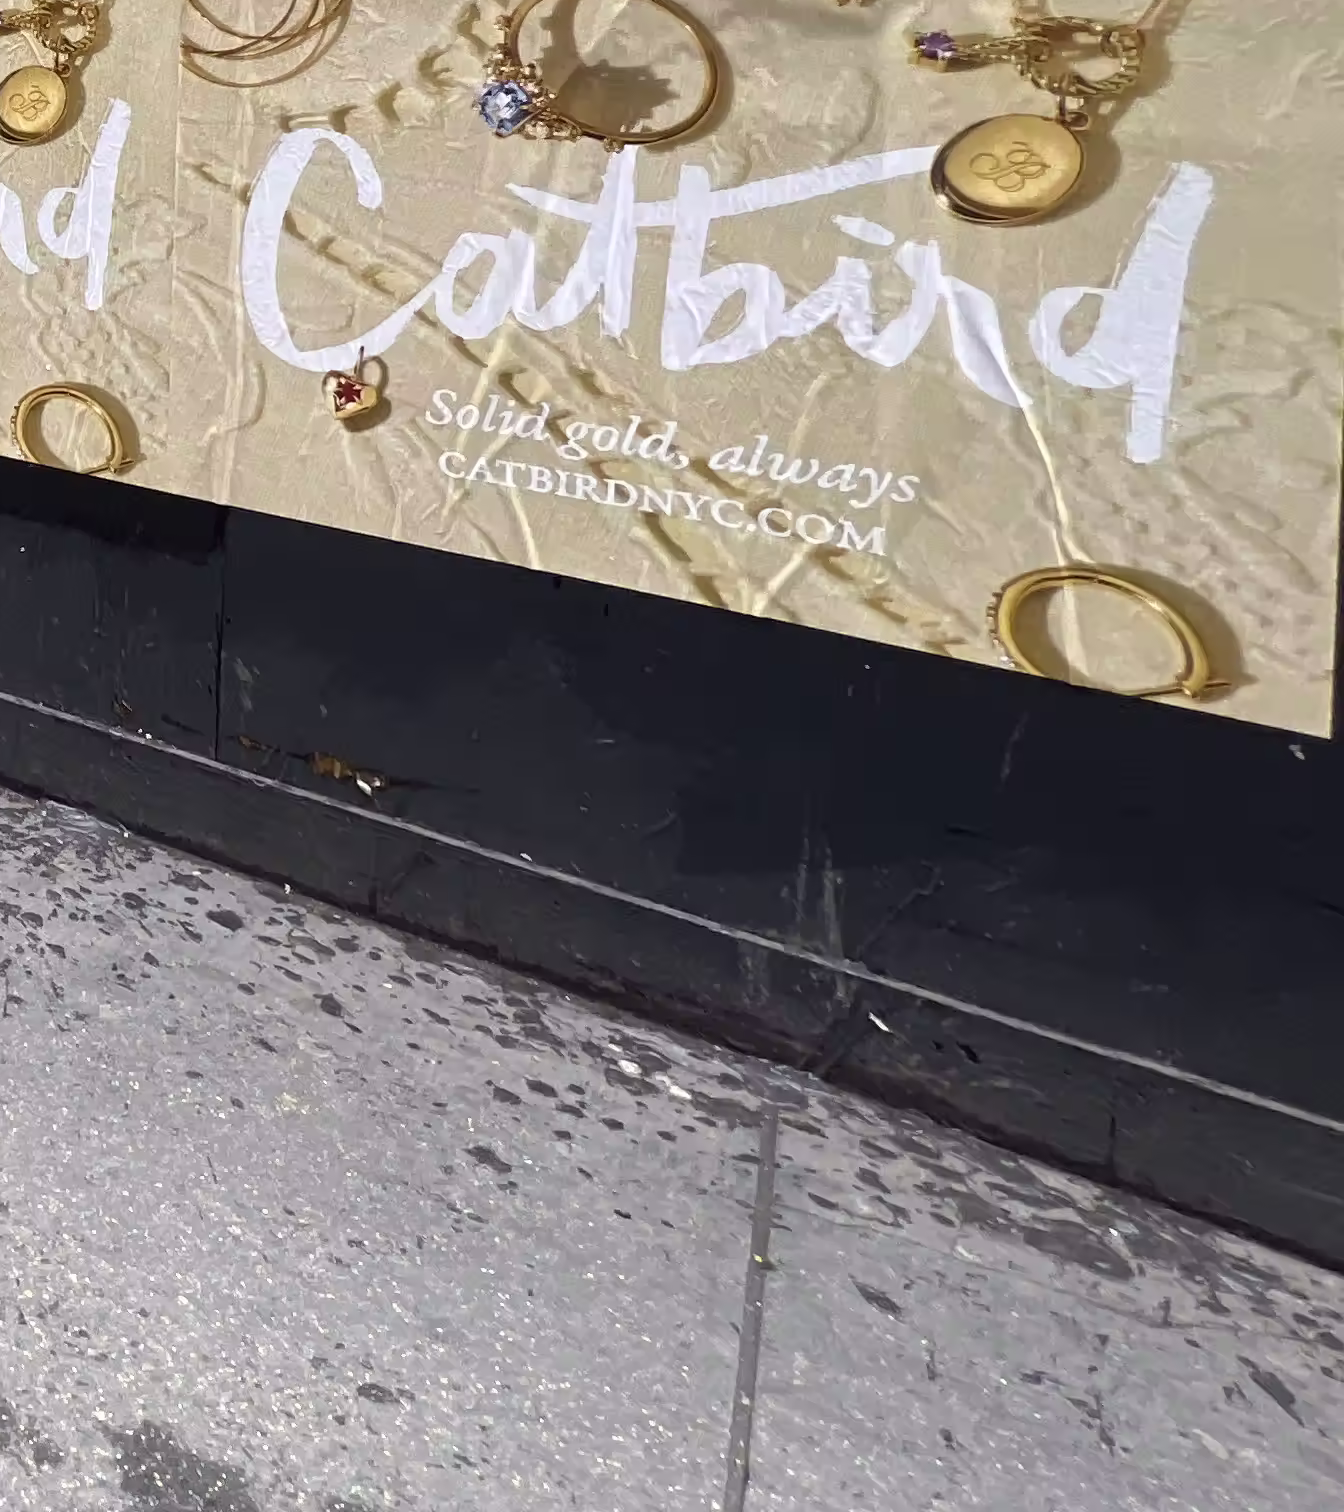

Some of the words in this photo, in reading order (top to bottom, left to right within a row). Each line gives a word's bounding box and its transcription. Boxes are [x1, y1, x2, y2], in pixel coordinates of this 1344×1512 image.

[240, 127, 1214, 464] Catbird
[424, 388, 550, 441] Solid
[556, 415, 690, 471] gold,
[708, 434, 920, 508] always
[438, 451, 887, 556] CATBIRDNYC.COM
